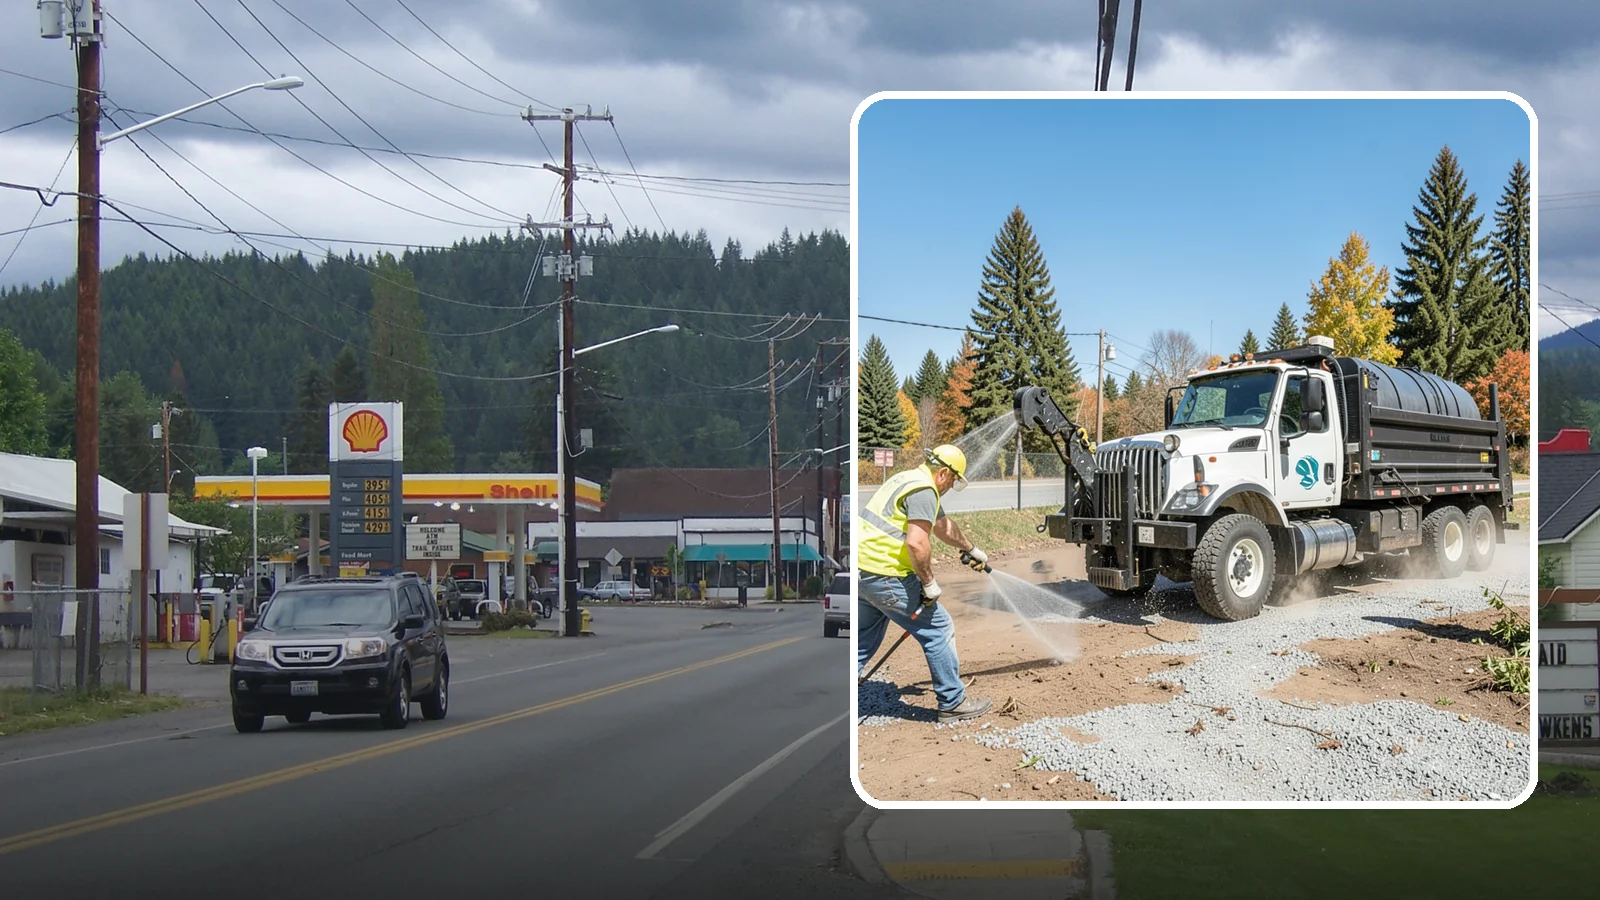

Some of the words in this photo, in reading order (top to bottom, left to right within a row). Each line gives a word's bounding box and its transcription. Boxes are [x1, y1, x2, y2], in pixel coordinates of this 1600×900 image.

[366, 480, 384, 490] 395
[490, 484, 547, 499] Shell
[365, 494, 384, 504] 405
[365, 508, 384, 518] 415
[366, 522, 384, 532] 429
[1539, 643, 1567, 666] AID
